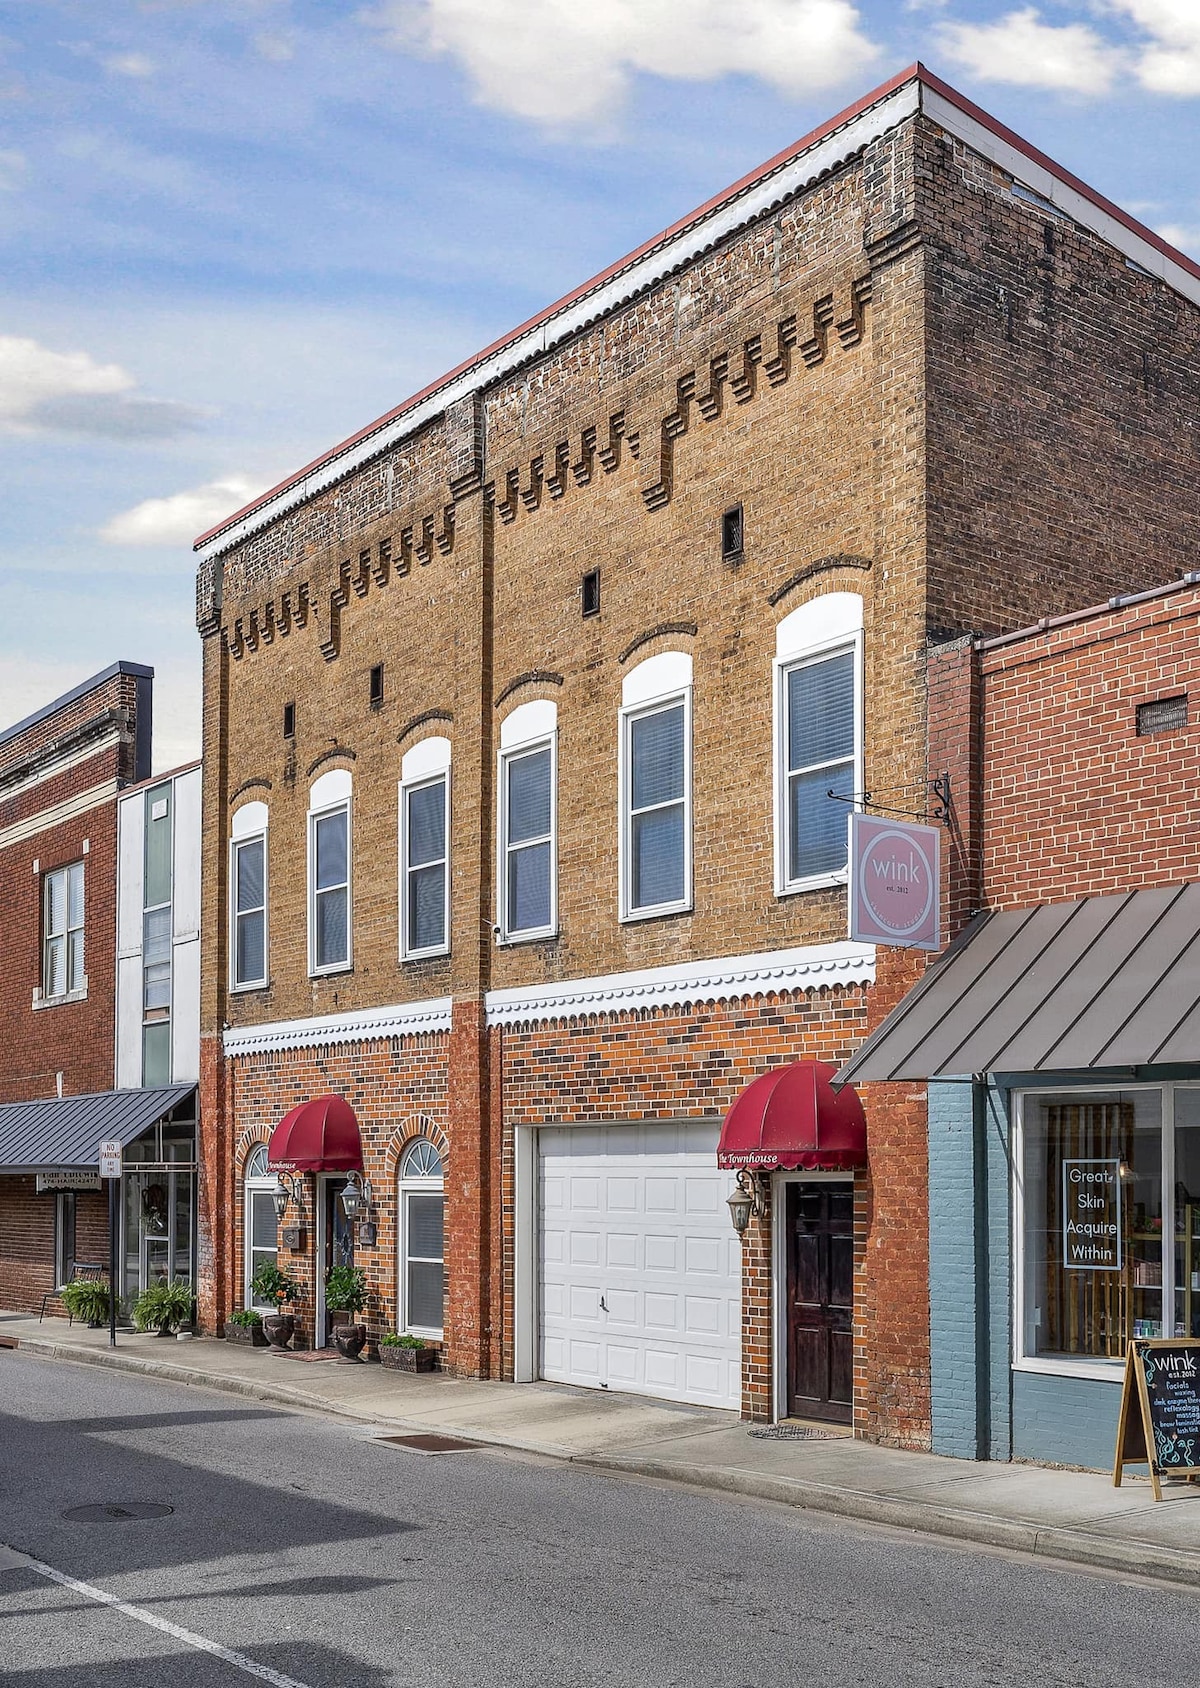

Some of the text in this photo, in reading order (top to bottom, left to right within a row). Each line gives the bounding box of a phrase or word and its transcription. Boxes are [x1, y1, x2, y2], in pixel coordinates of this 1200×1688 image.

[872, 851, 920, 884] wink
[896, 886, 909, 895] 2012
[106, 1143, 115, 1151] NO
[728, 1152, 778, 1163] Townhouse
[1069, 1168, 1110, 1183] Great
[1078, 1193, 1105, 1209] Skin
[1066, 1219, 1117, 1238] Acquire
[1072, 1244, 1112, 1260] Within
[1154, 1350, 1197, 1371] wink
[1166, 1380, 1190, 1390] facials
[1174, 1390, 1196, 1398] waxing
